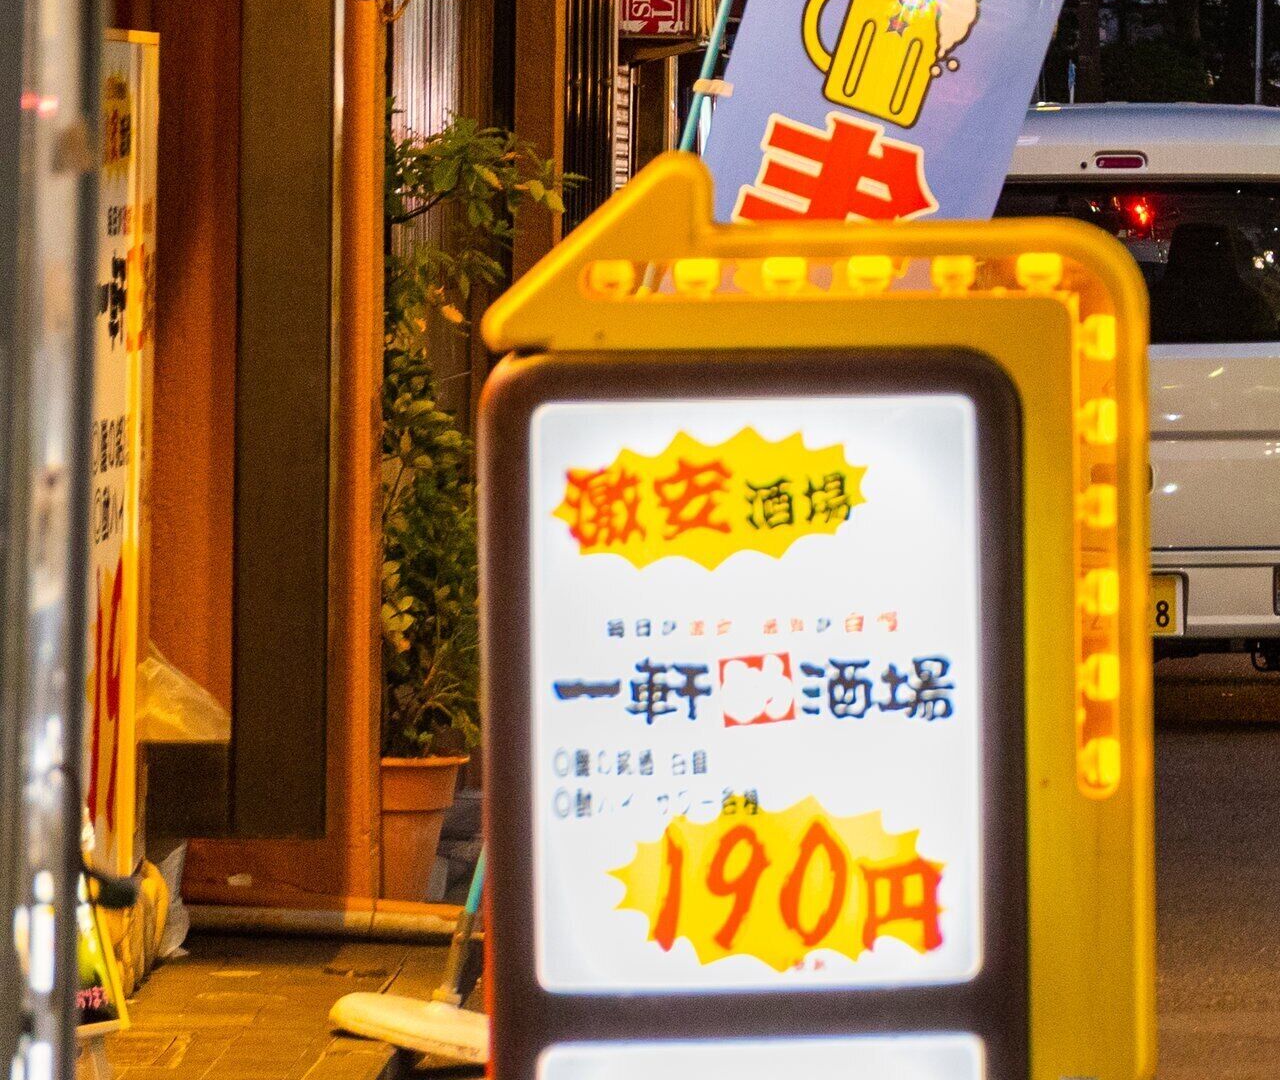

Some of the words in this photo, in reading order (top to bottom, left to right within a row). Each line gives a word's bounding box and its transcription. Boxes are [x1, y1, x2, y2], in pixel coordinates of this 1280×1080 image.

[565, 455, 853, 552] 激安酒場
[647, 819, 946, 953] 190円
